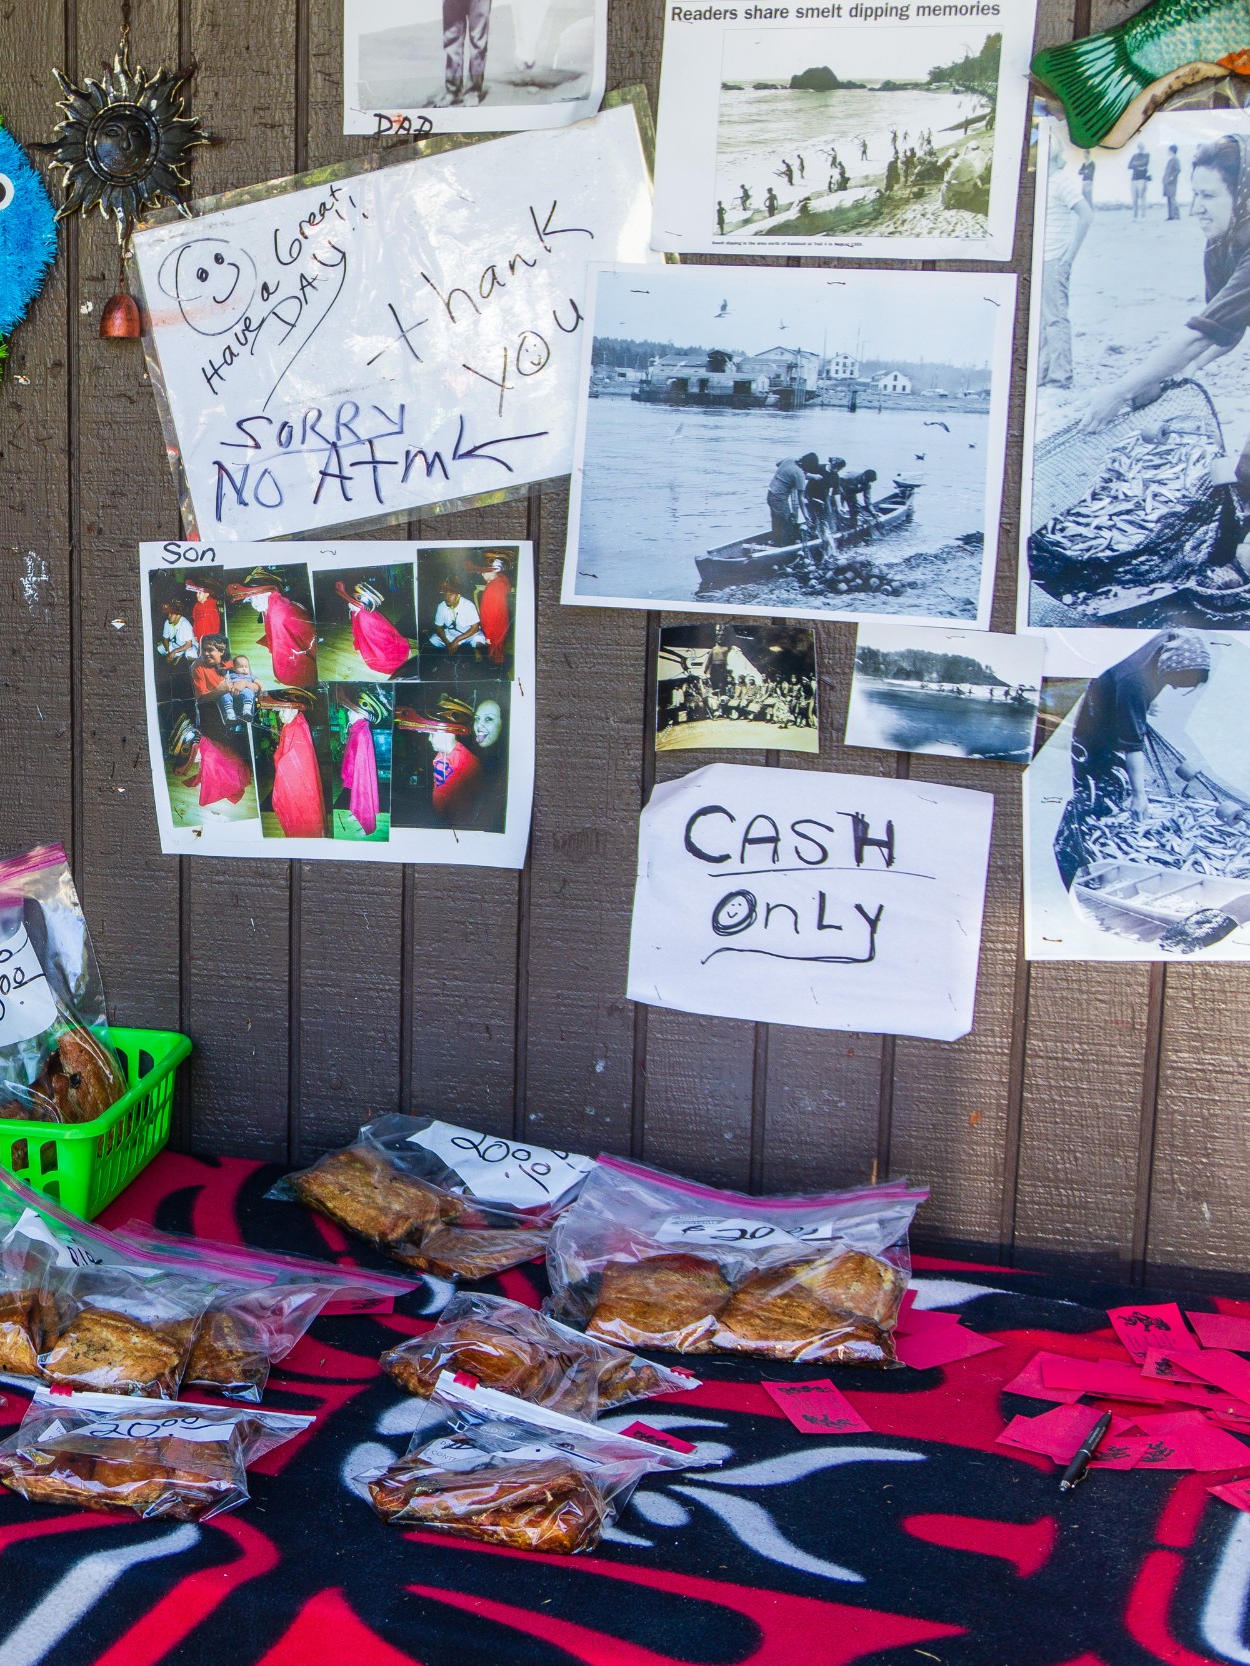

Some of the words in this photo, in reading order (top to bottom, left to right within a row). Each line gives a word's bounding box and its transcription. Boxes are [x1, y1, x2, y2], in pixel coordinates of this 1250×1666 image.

[671, 6, 738, 21] Readers
[744, 5, 789, 19] share
[796, 4, 842, 18] smelt
[849, 2, 910, 21] dipping
[916, 1, 1000, 16] memories
[373, 112, 434, 135] DAD
[213, 459, 283, 522] NO
[161, 541, 217, 565] Son
[684, 805, 896, 868] CASH
